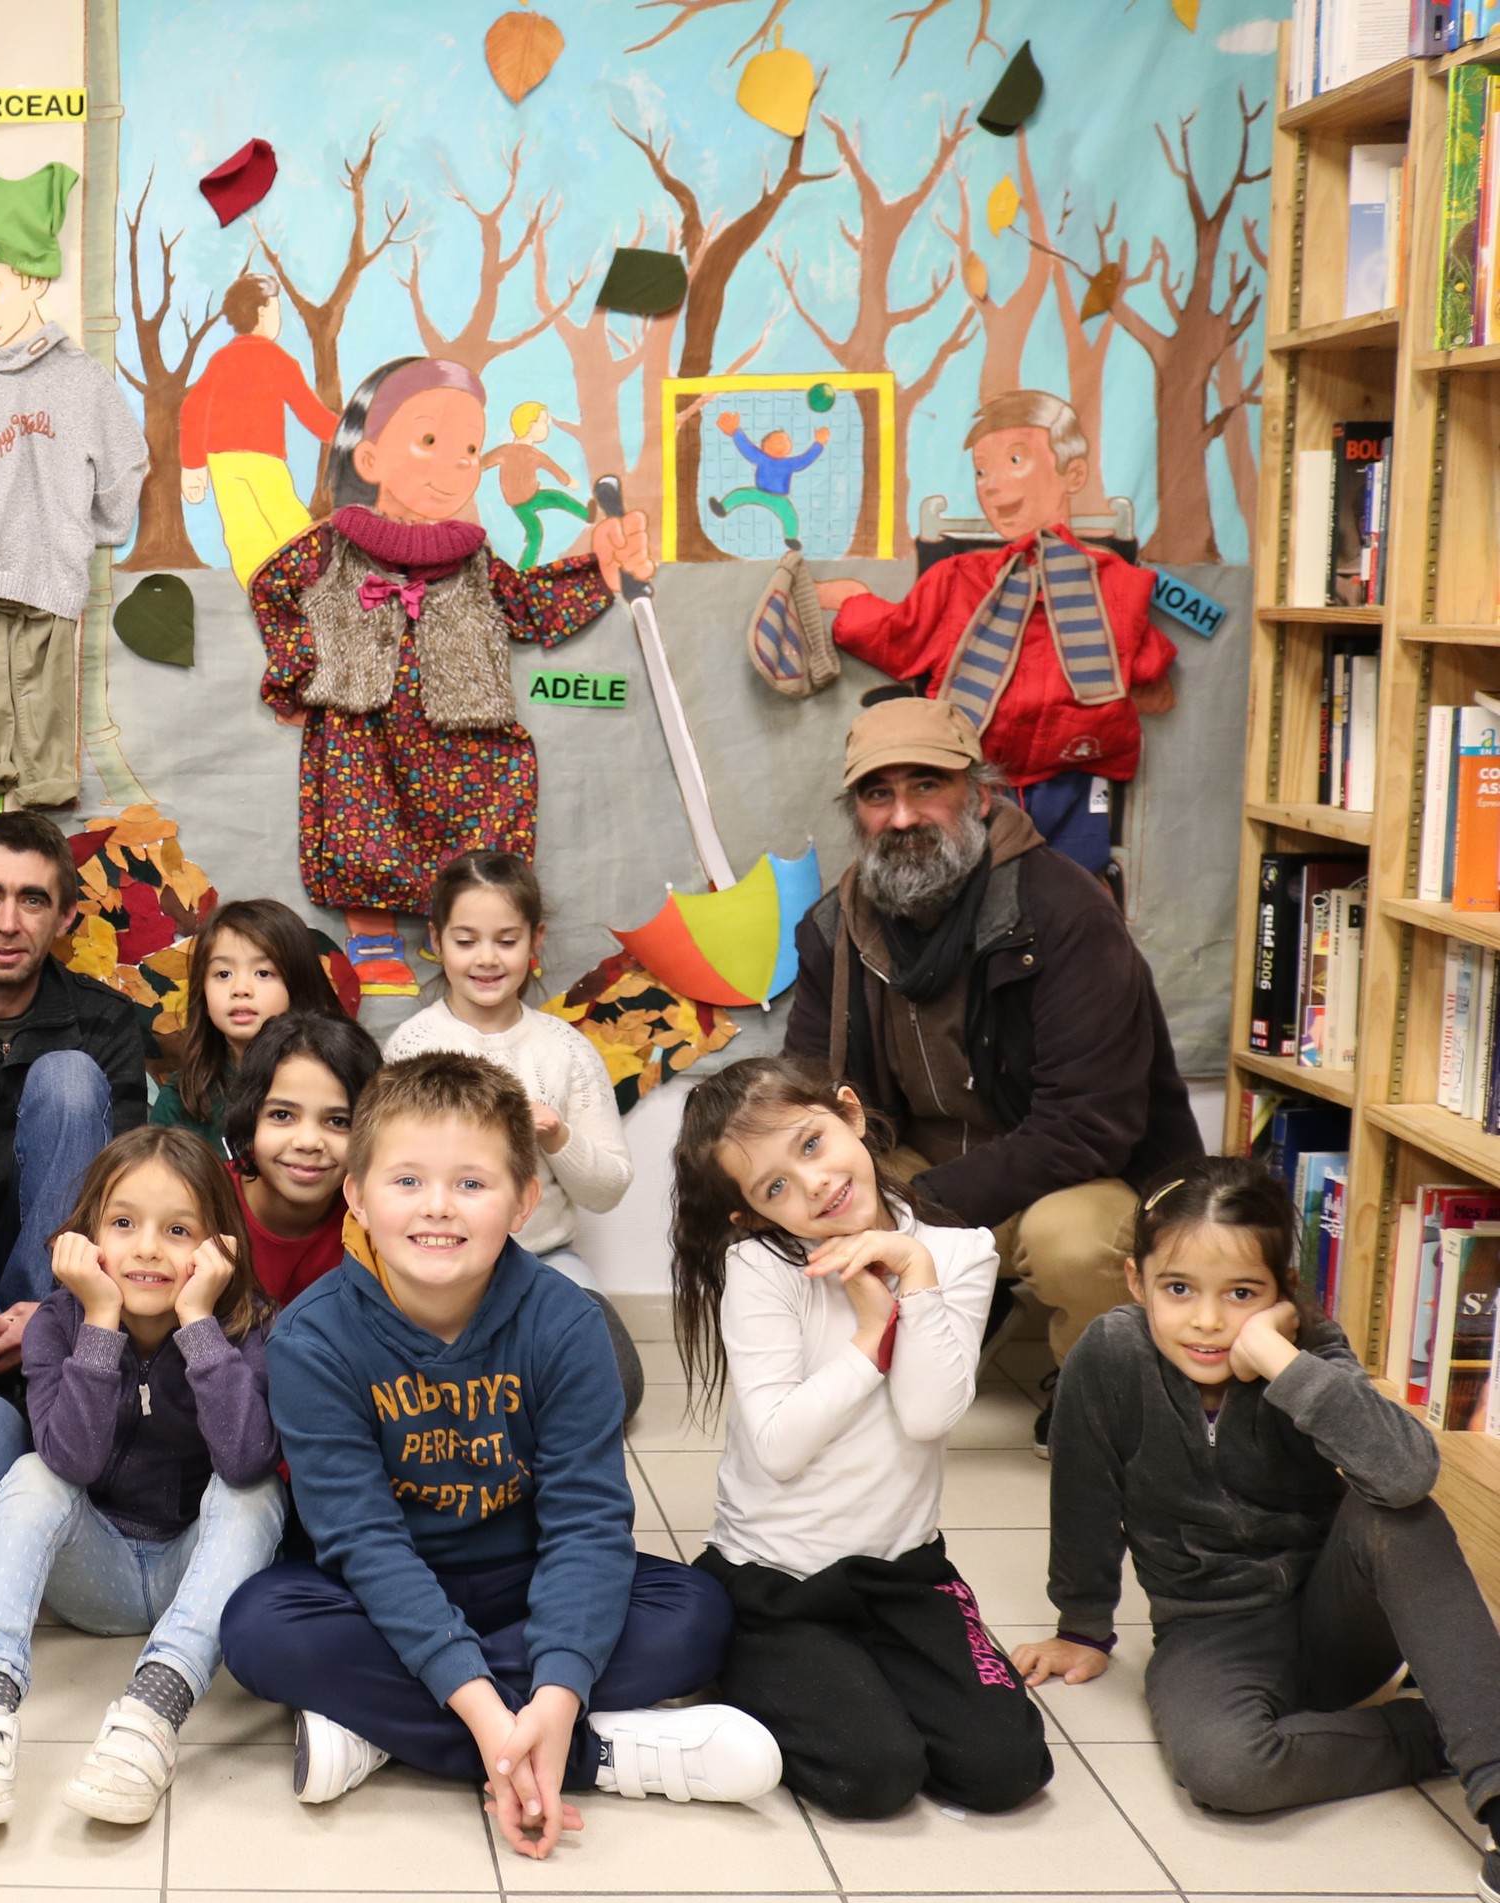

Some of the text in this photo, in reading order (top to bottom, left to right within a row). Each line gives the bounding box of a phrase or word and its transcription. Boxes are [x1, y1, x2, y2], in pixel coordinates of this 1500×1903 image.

[530, 673, 626, 701] ADÈLE
[1262, 903, 1276, 948] quid
[1260, 949, 1274, 991] 2006
[1253, 1020, 1268, 1036] RTL
